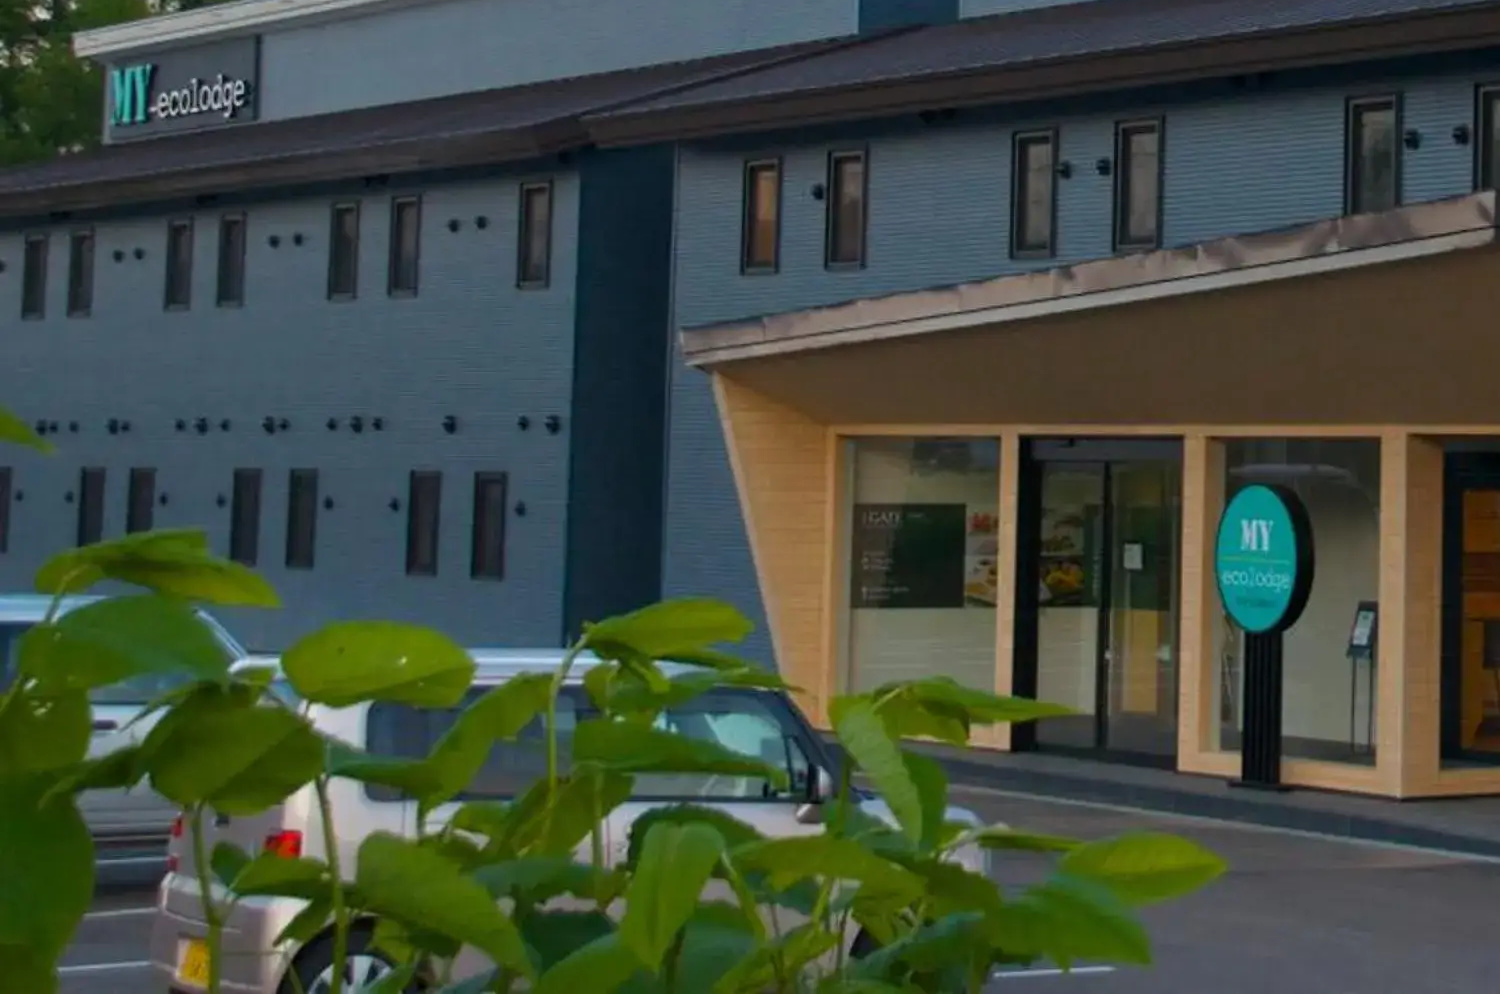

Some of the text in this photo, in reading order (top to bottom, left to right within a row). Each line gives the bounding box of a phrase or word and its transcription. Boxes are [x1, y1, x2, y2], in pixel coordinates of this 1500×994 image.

[111, 63, 152, 125] MY
[1240, 519, 1274, 551] MY
[1222, 566, 1291, 593] ecolodge
